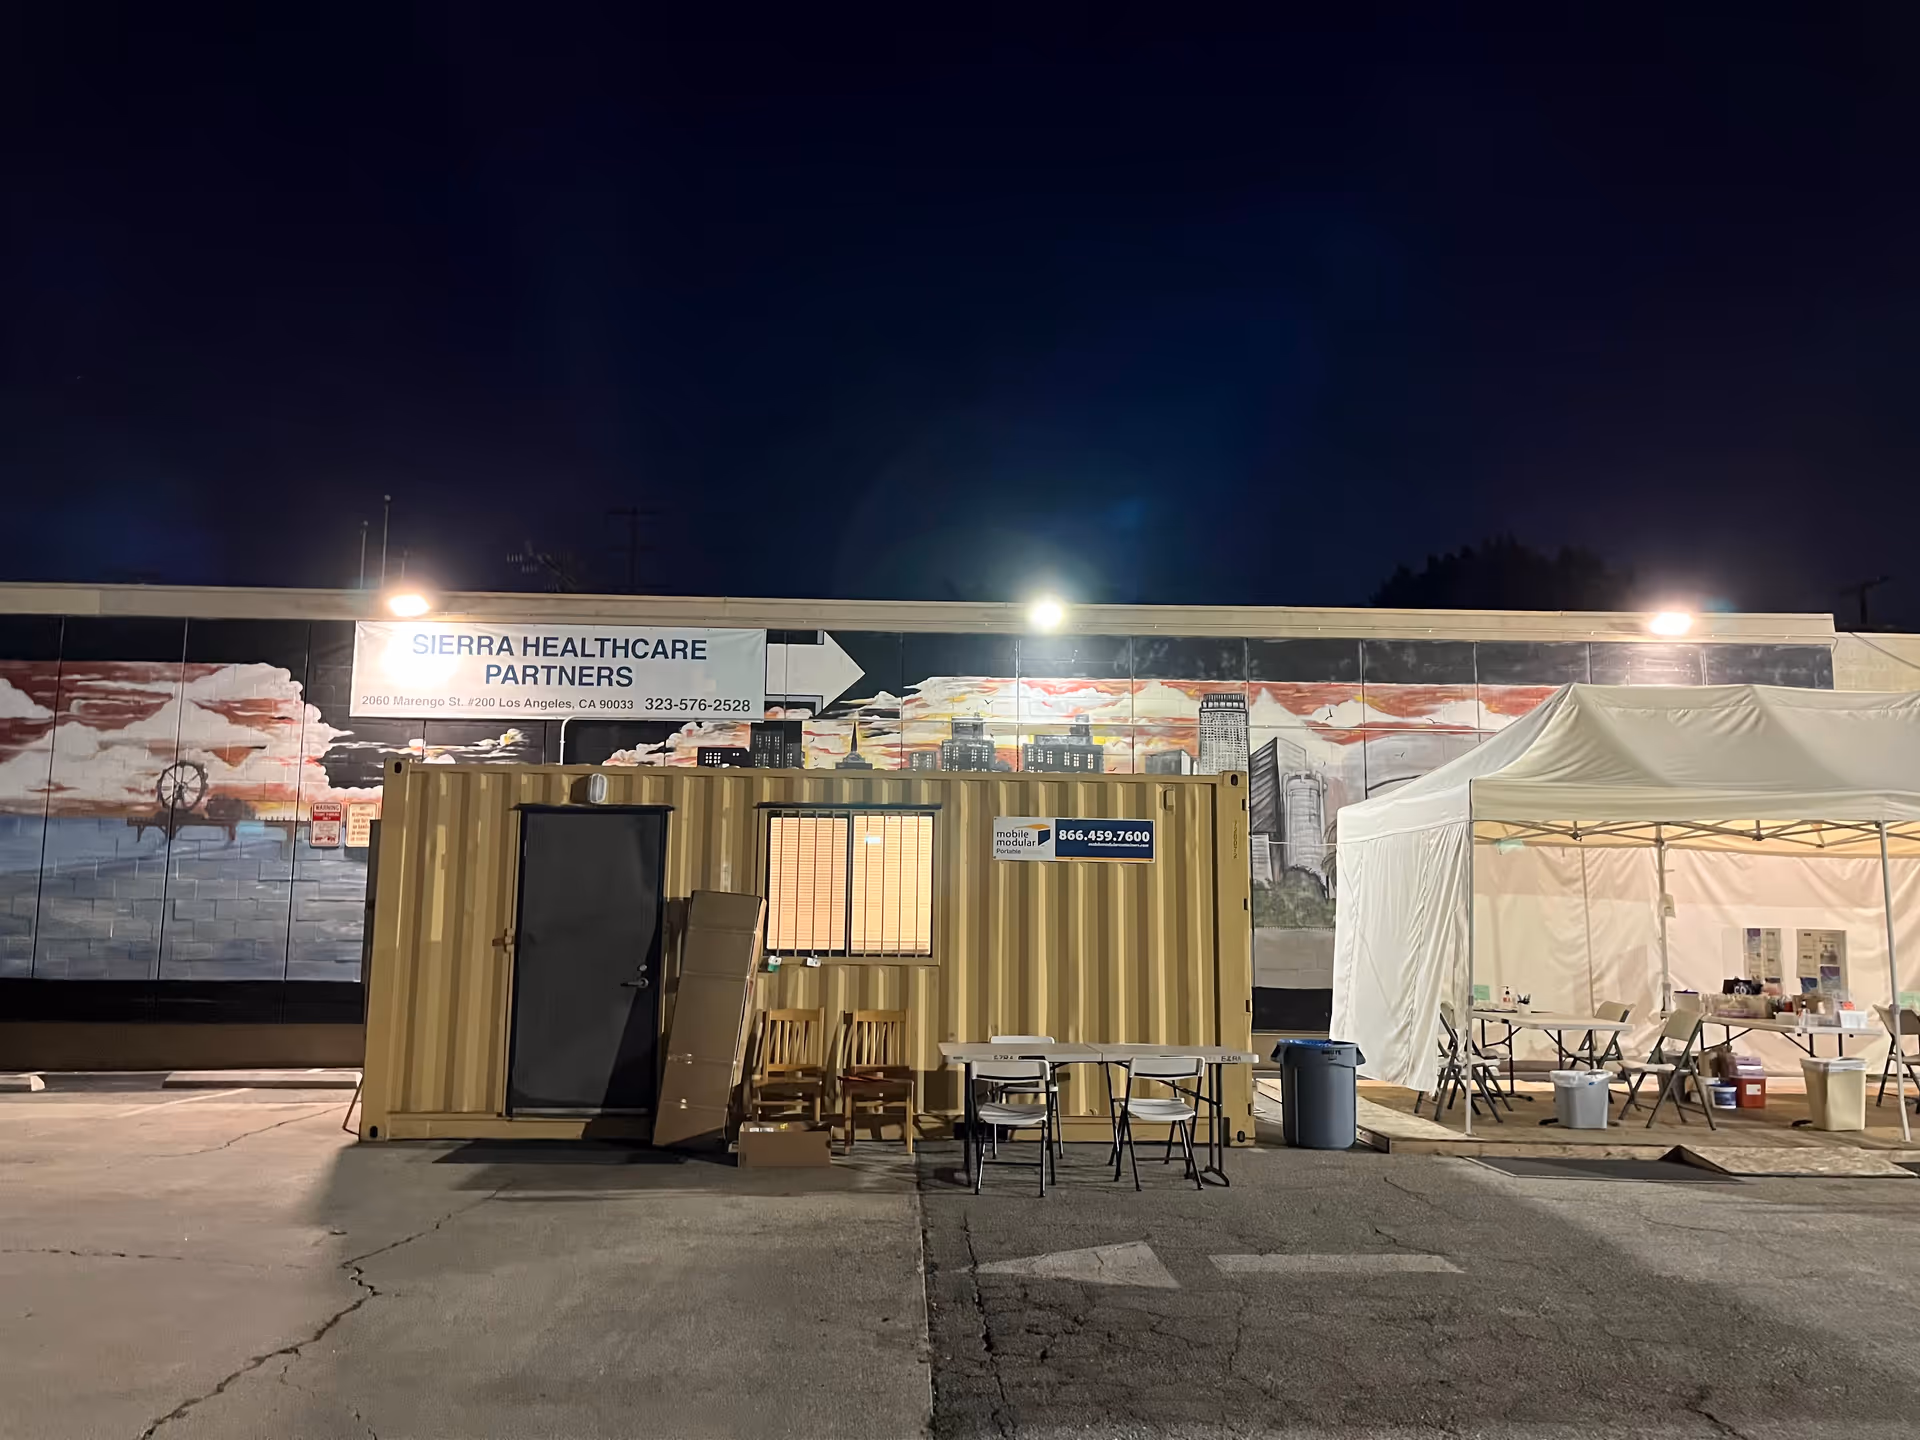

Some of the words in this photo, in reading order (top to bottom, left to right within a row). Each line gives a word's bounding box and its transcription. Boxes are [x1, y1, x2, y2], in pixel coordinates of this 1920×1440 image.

[412, 633, 515, 657] SIERRA
[522, 636, 707, 660] HEALTHCARE
[485, 664, 633, 688] PARTNERS
[361, 695, 390, 706] 2060
[393, 695, 445, 709] Marengo
[448, 696, 464, 707] St.
[467, 697, 496, 708] #200
[499, 697, 521, 708] Los
[524, 697, 575, 711] Angeles,
[578, 699, 597, 710] CA
[599, 699, 634, 710] 90033
[644, 698, 751, 713] 323-576-2528
[996, 829, 1029, 838] mobile
[1058, 829, 1150, 842] 866.459.7600
[996, 838, 1036, 847] modular
